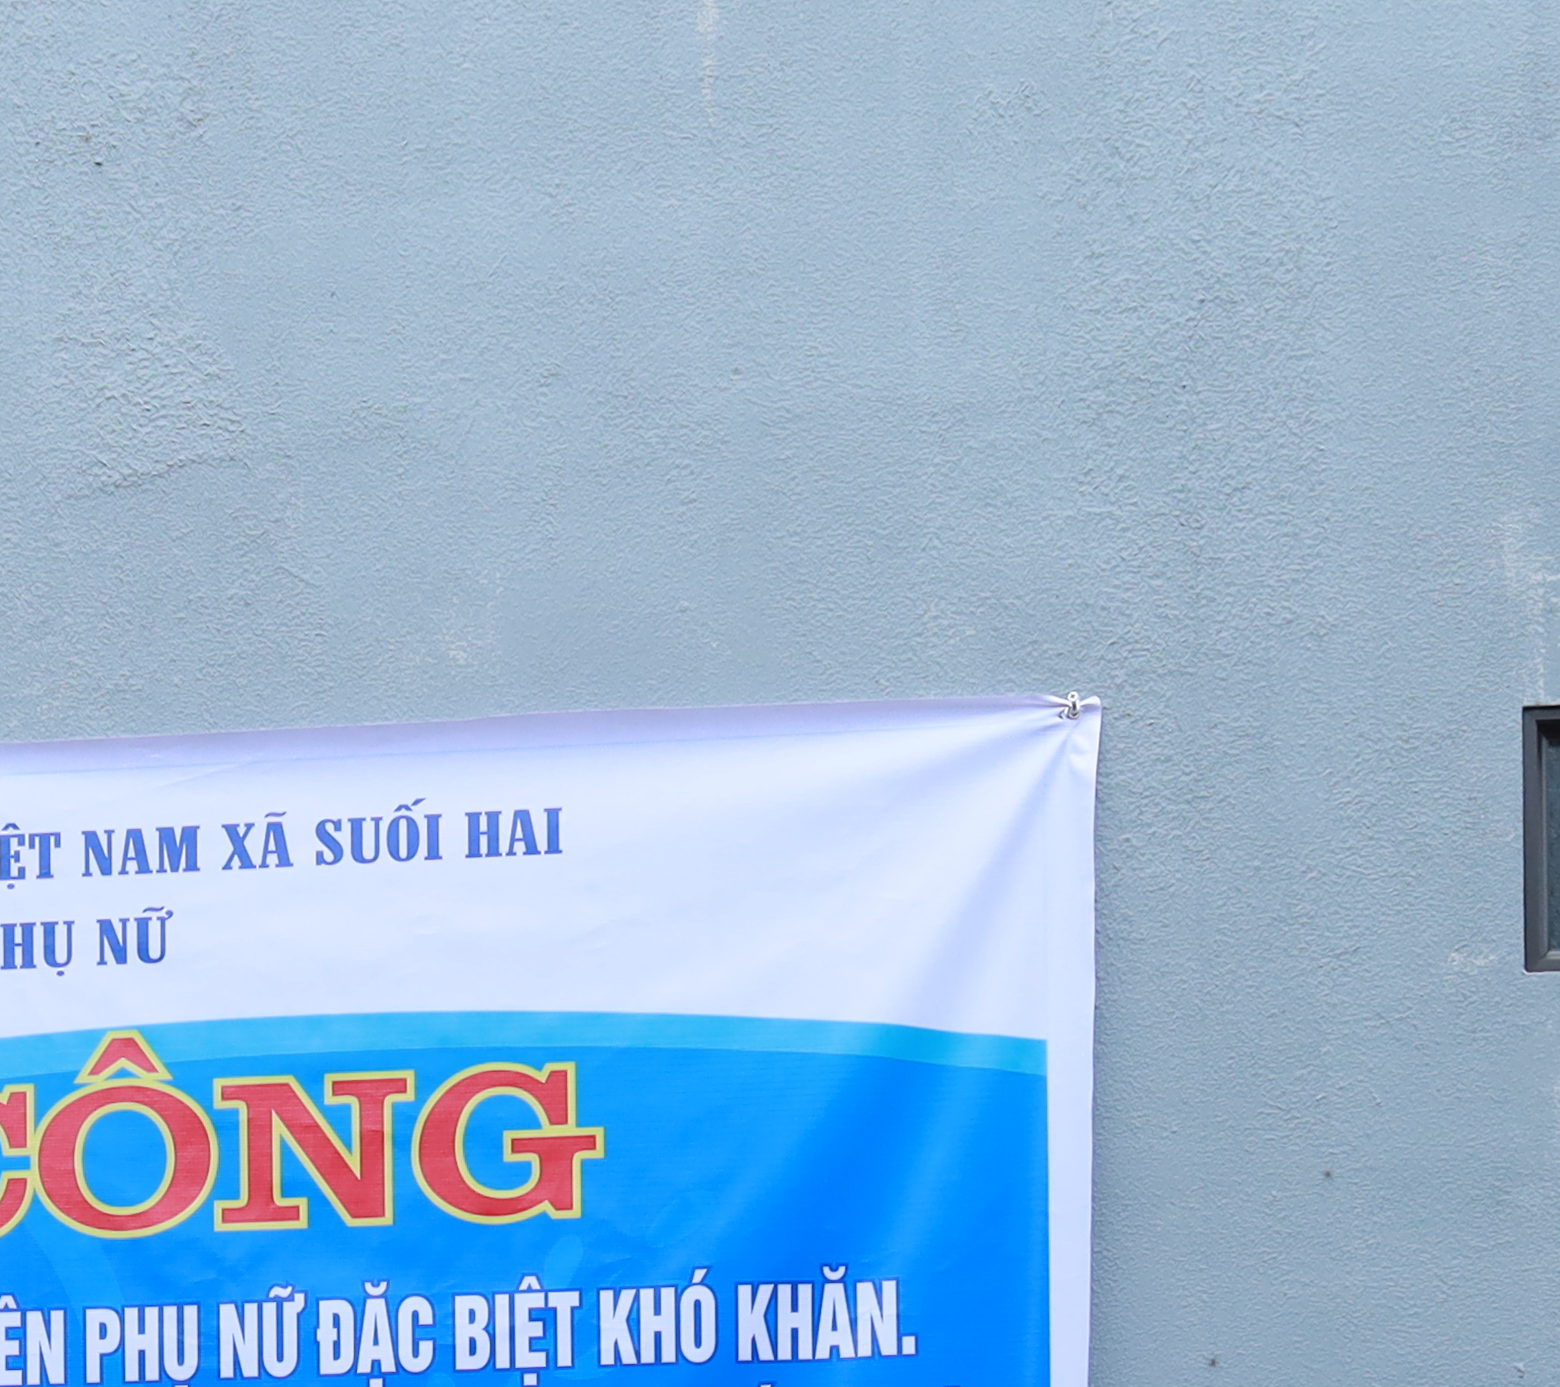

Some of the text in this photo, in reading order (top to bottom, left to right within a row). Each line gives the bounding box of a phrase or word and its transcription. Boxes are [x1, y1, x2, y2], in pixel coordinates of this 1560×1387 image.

[81, 826, 200, 877] NAM
[221, 811, 293, 871] XÃ
[315, 799, 443, 866] SUỐI
[464, 807, 564, 858] HAI
[96, 907, 174, 965] NỮ
[218, 1284, 307, 1379] NỮ
[453, 1274, 580, 1386] BIỆT
[599, 1268, 717, 1366] KHÓ
[736, 1265, 917, 1361] KHĂN.
